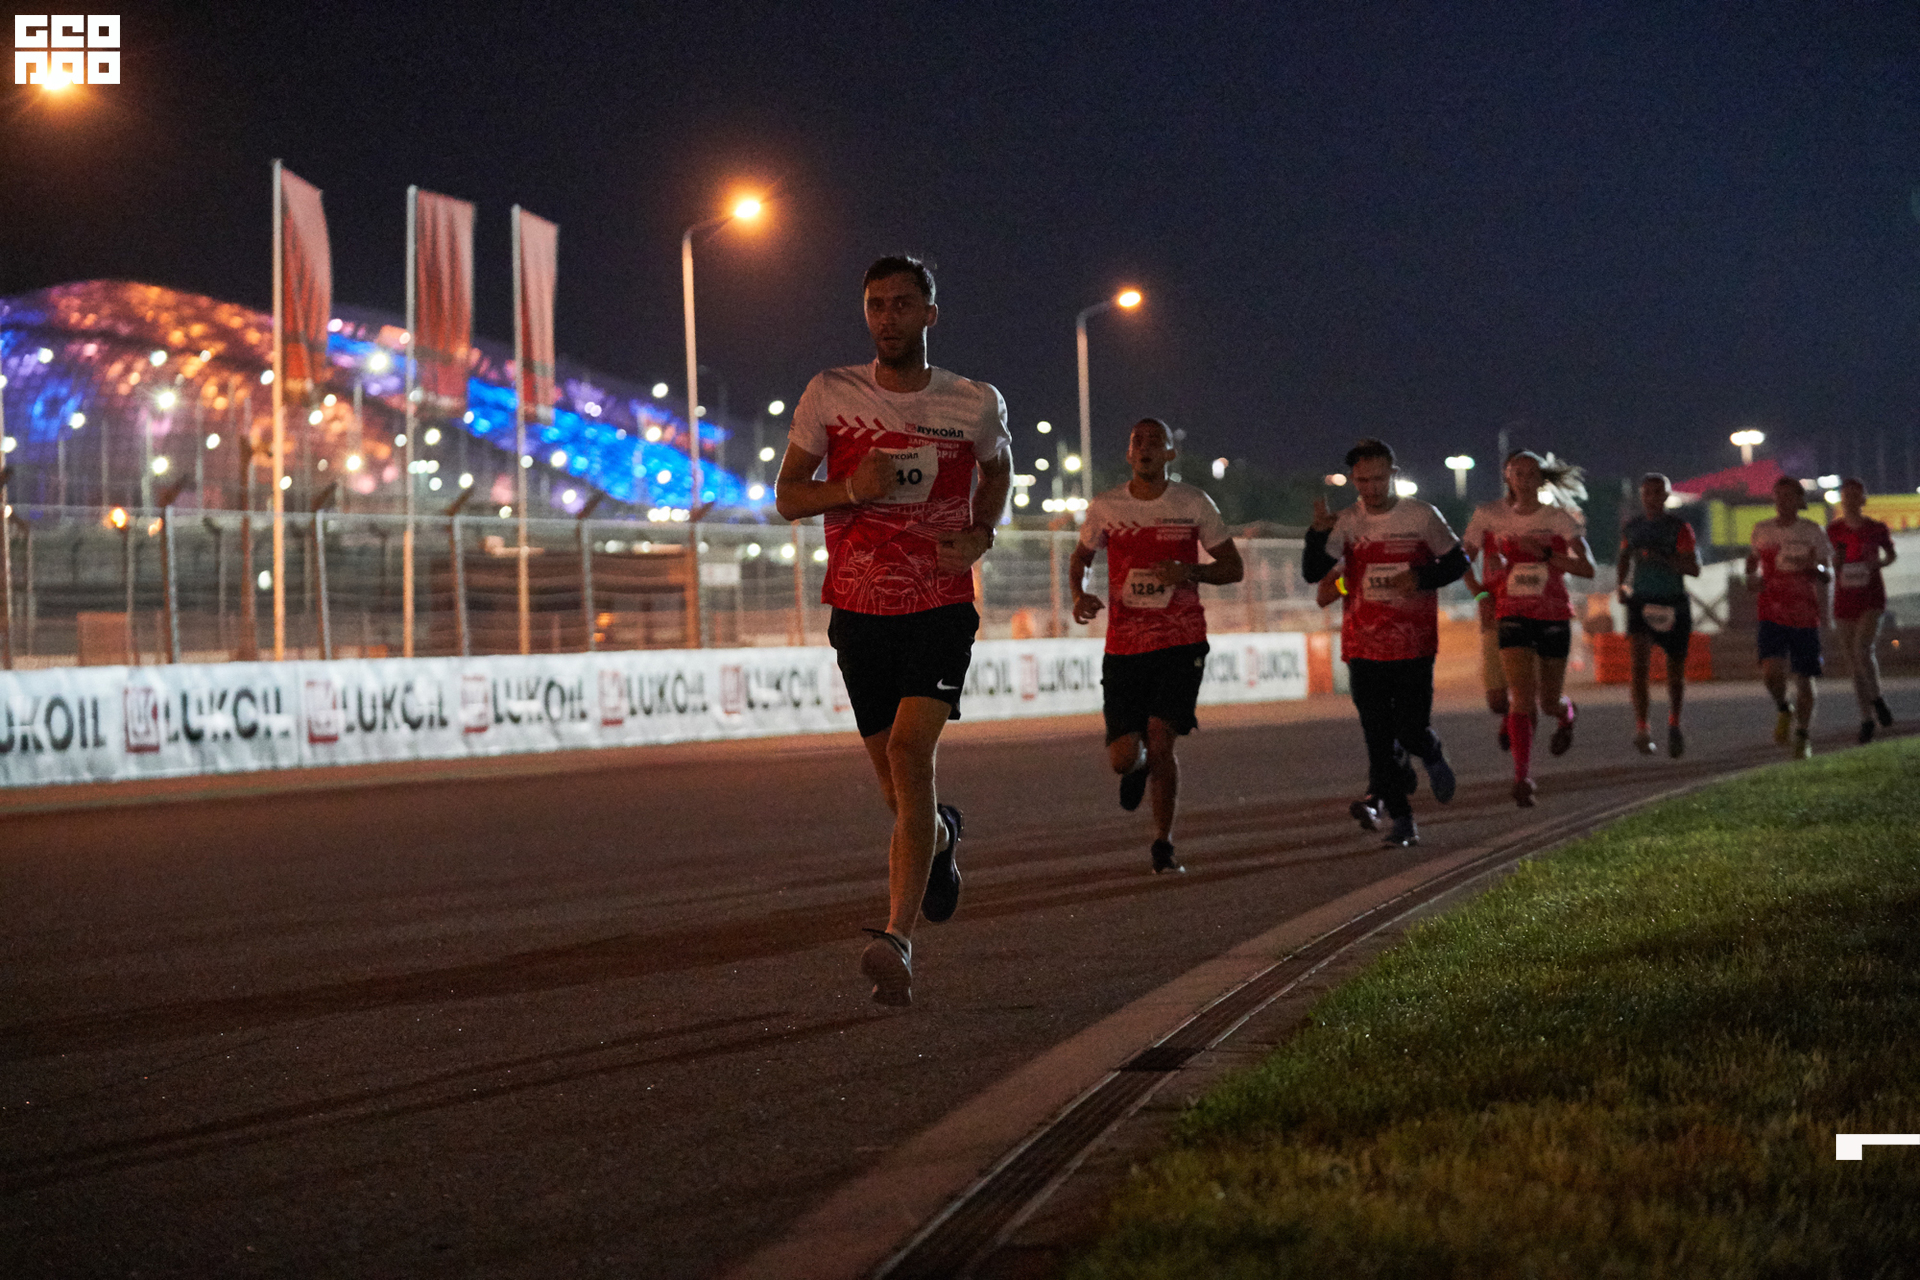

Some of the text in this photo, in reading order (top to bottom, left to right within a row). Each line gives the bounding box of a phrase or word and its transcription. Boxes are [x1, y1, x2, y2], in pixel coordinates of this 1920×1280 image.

[917, 425, 964, 439] ЛУКОЙЛ
[890, 452, 918, 460] УКОЙЛ
[1131, 583, 1165, 595] 1284
[0, 694, 106, 753] UKOIL
